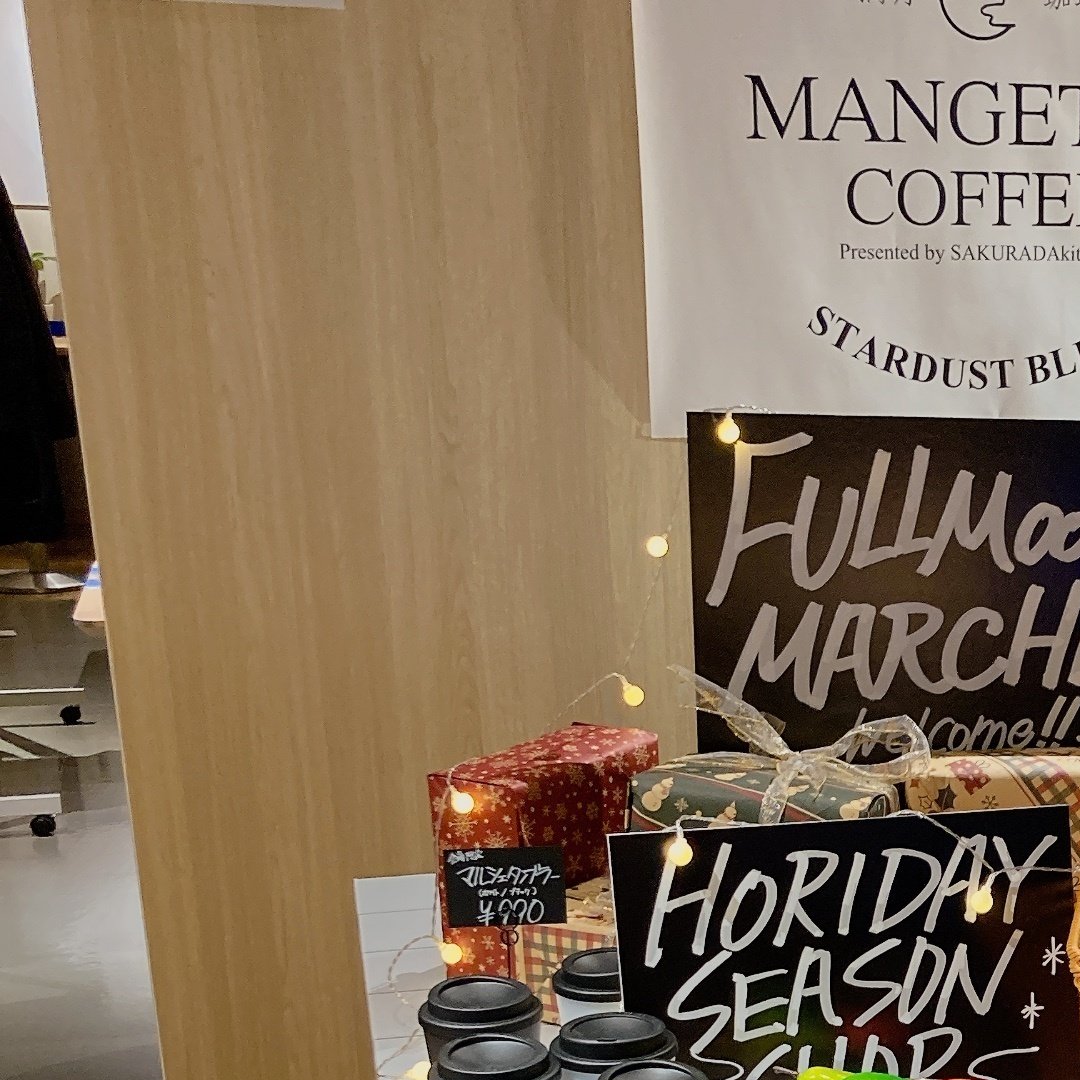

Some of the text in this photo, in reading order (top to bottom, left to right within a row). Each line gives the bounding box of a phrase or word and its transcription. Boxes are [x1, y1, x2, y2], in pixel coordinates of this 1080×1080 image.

[839, 242, 919, 262] Presented
[924, 242, 945, 265] by
[807, 304, 1015, 391] STARDUST
[645, 834, 1058, 969] HORIDAY
[666, 929, 1024, 1058] SEASON
